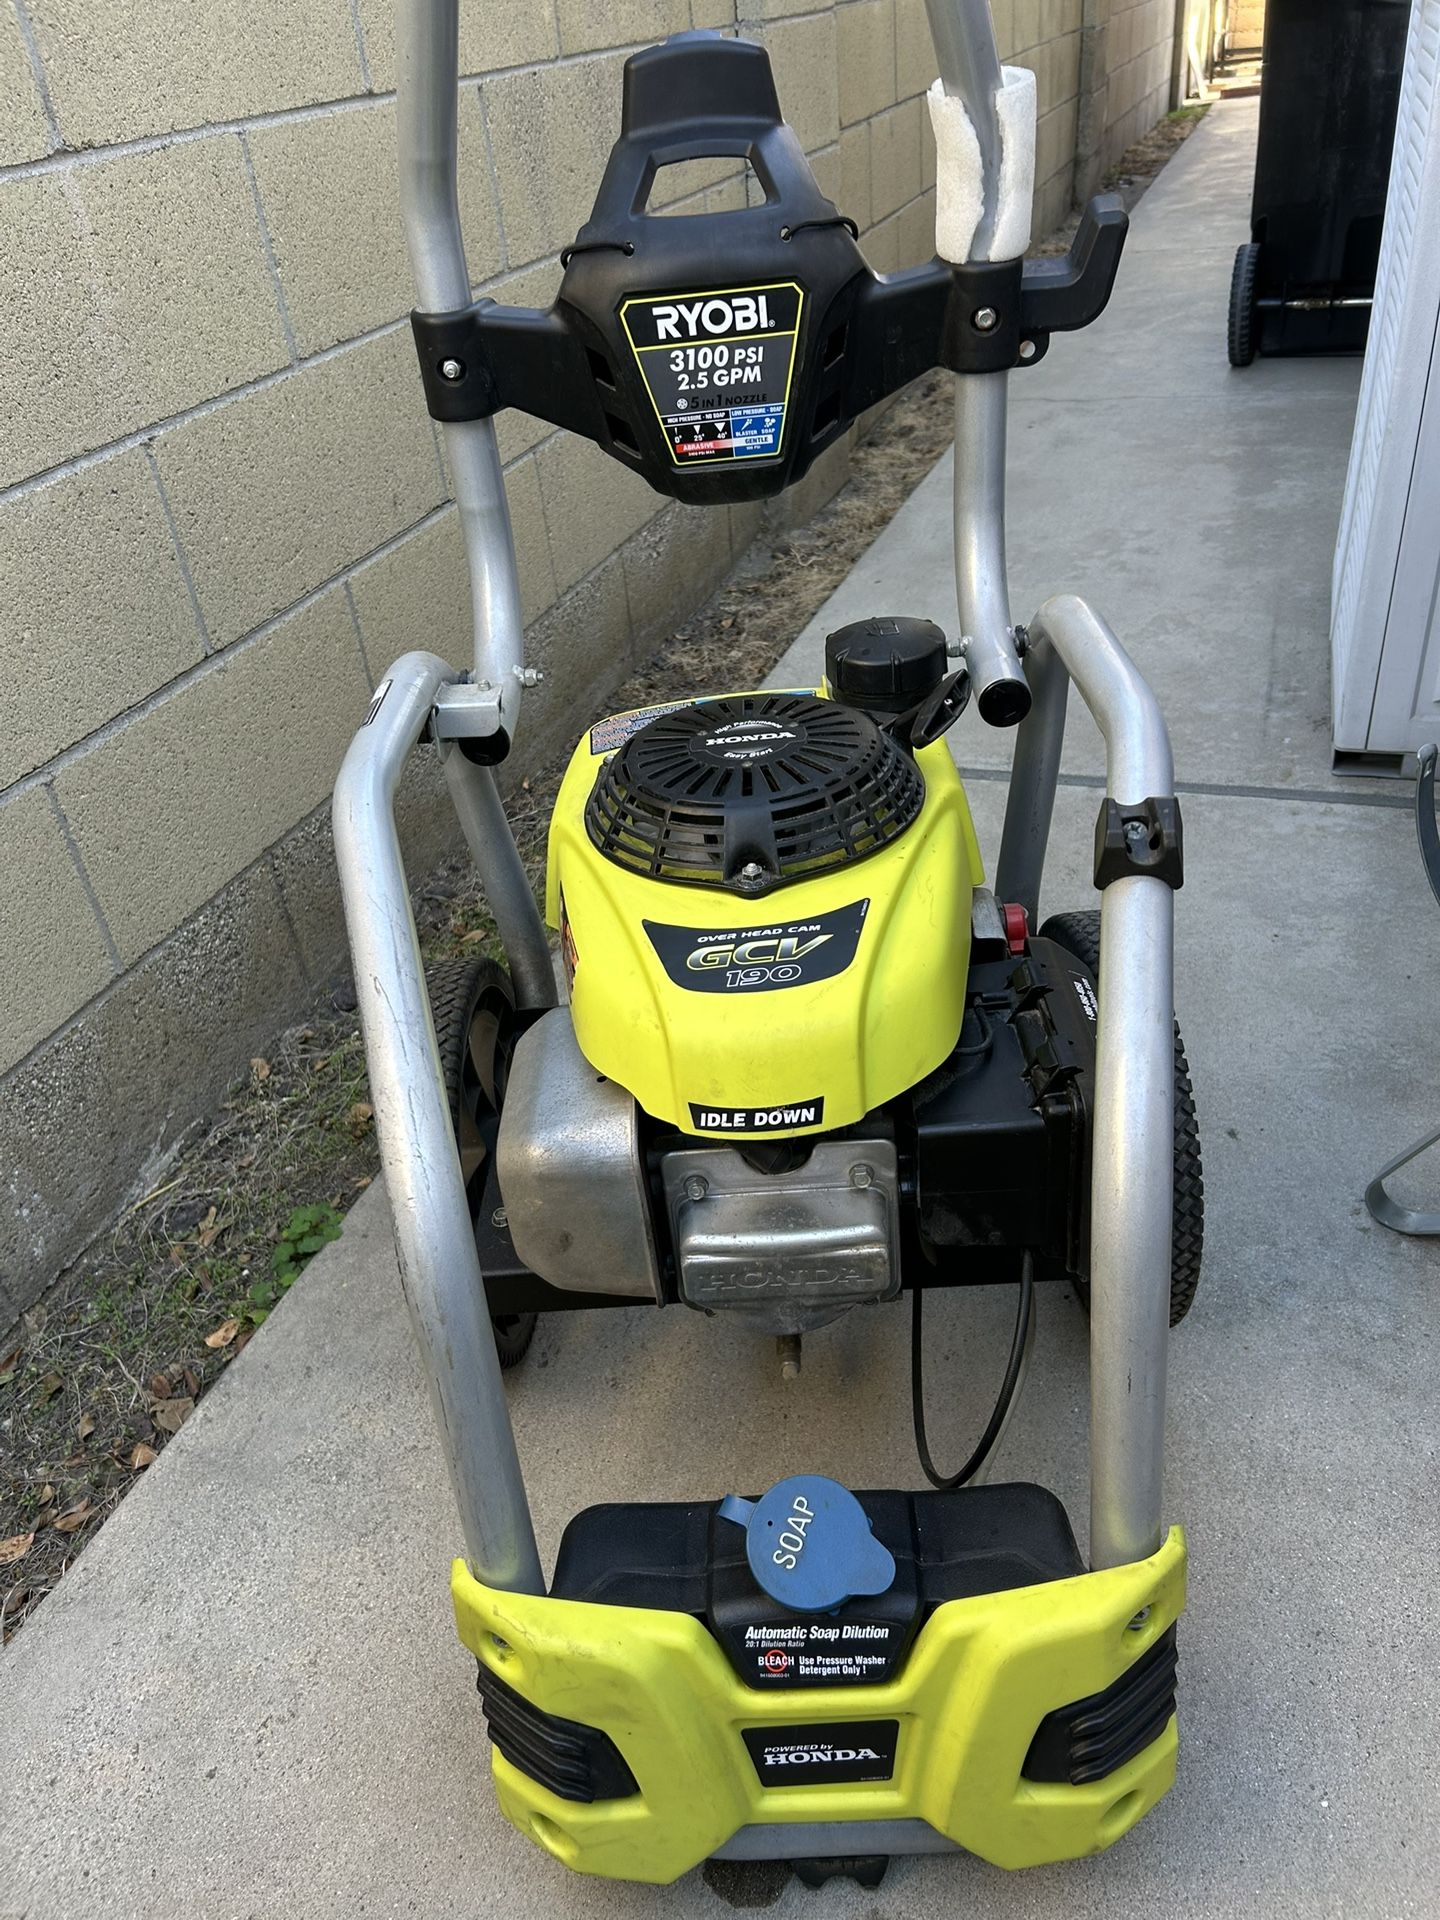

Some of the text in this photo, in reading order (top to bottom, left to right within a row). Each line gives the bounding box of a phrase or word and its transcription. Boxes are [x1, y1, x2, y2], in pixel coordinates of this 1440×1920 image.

[669, 345, 764, 372] 3100 PSI
[677, 365, 762, 391] 2.5 GPM
[690, 396, 699, 409] 5
[702, 398, 715, 408] IN
[725, 393, 768, 405] NOZZLE
[679, 414, 702, 423] PRESSURE
[683, 442, 714, 451] ABRASIVE
[745, 436, 769, 444] GENTLE
[733, 720, 783, 729] Performance
[705, 731, 797, 746] HONDA
[723, 747, 774, 760] Easy Start
[697, 924, 821, 943] OVER HEAD CAM
[686, 934, 834, 971] GCV
[726, 964, 802, 988] 190
[700, 1107, 815, 1127] IDLE DOWN
[698, 1267, 875, 1291] HONDA
[772, 1495, 815, 1570] SOAP
[744, 1625, 889, 1642] Automatic Soap Dilution
[745, 1640, 805, 1648] 20:1 Dilution Ratio
[757, 1656, 795, 1667] BLEACH
[798, 1655, 886, 1665] Use Pressure Washer
[799, 1665, 841, 1676] Detergent
[842, 1665, 861, 1676] Only
[764, 1743, 834, 1753] POWERED by
